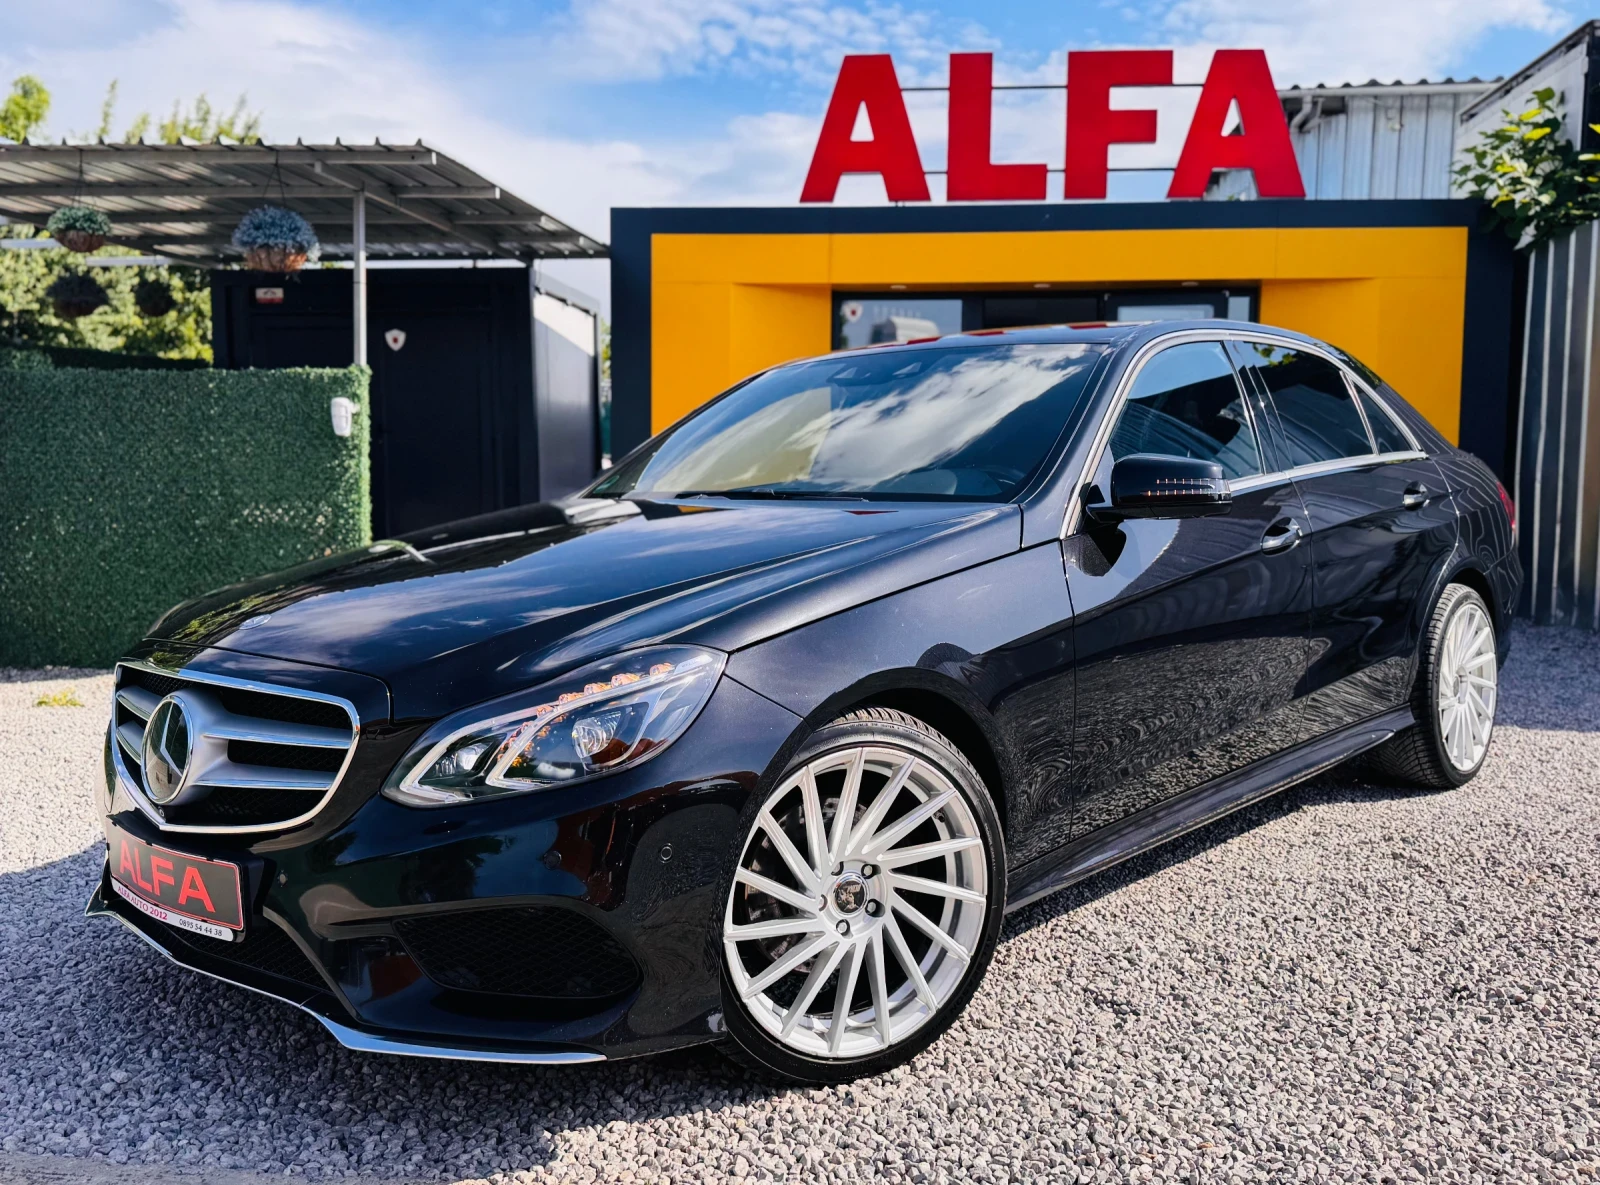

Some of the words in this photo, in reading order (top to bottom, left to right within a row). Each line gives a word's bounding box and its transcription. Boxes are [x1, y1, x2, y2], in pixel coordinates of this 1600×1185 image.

[800, 49, 1306, 203] ALFA
[117, 886, 131, 900] ALFA
[131, 896, 148, 911] AUTO
[150, 906, 168, 920] 2012
[178, 918, 194, 929] 0895
[194, 923, 203, 932] 54
[204, 926, 213, 934] 44
[213, 928, 223, 937] 38
[119, 839, 216, 913] ALFA
